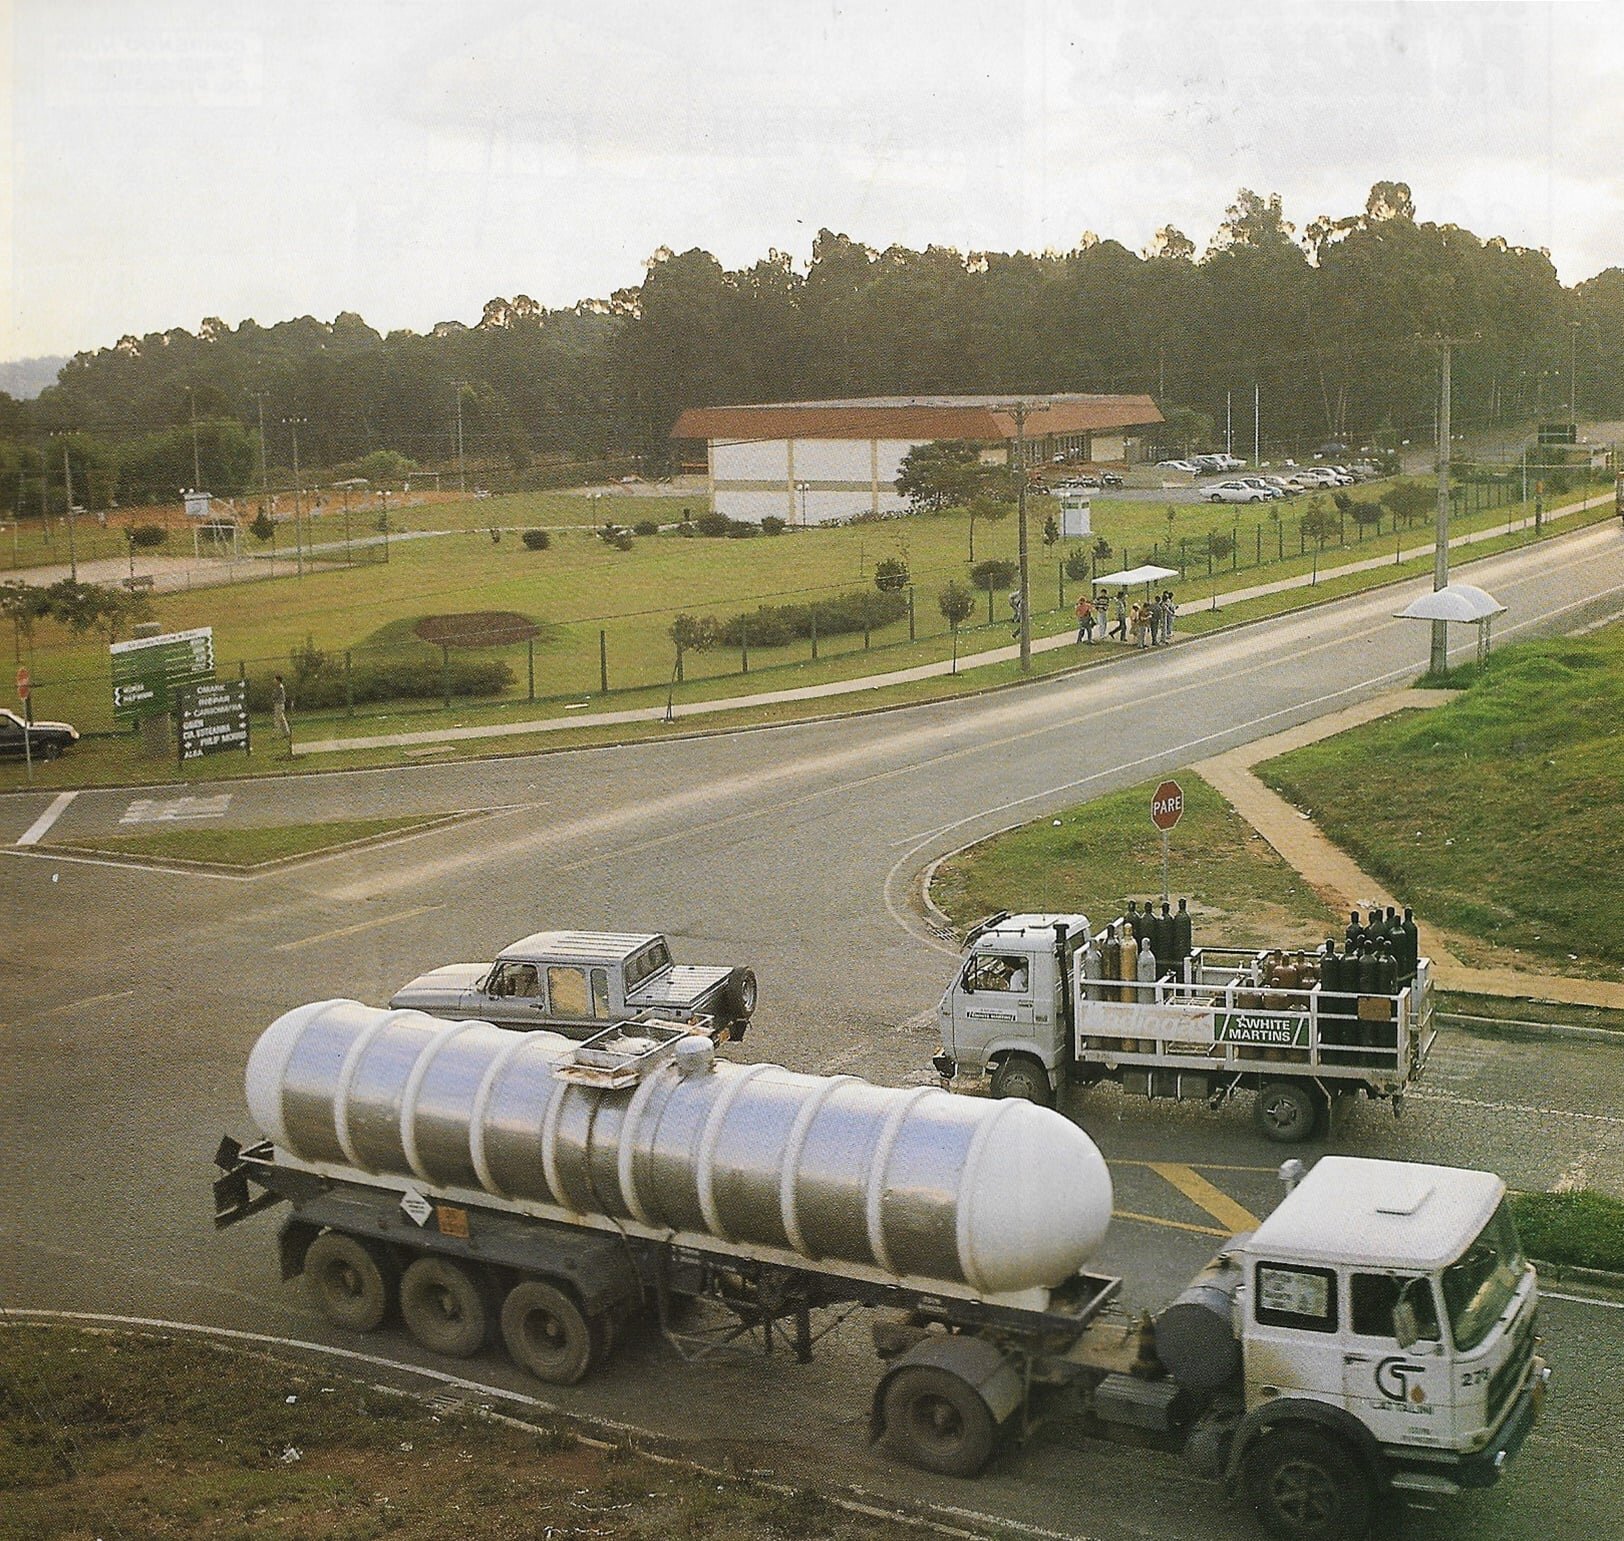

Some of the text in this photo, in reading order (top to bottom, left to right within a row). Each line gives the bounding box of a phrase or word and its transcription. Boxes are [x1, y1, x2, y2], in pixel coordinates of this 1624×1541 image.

[1153, 796, 1182, 816] PARE
[1245, 1018, 1291, 1031] WHITE
[1229, 1029, 1291, 1042] MARTINS
